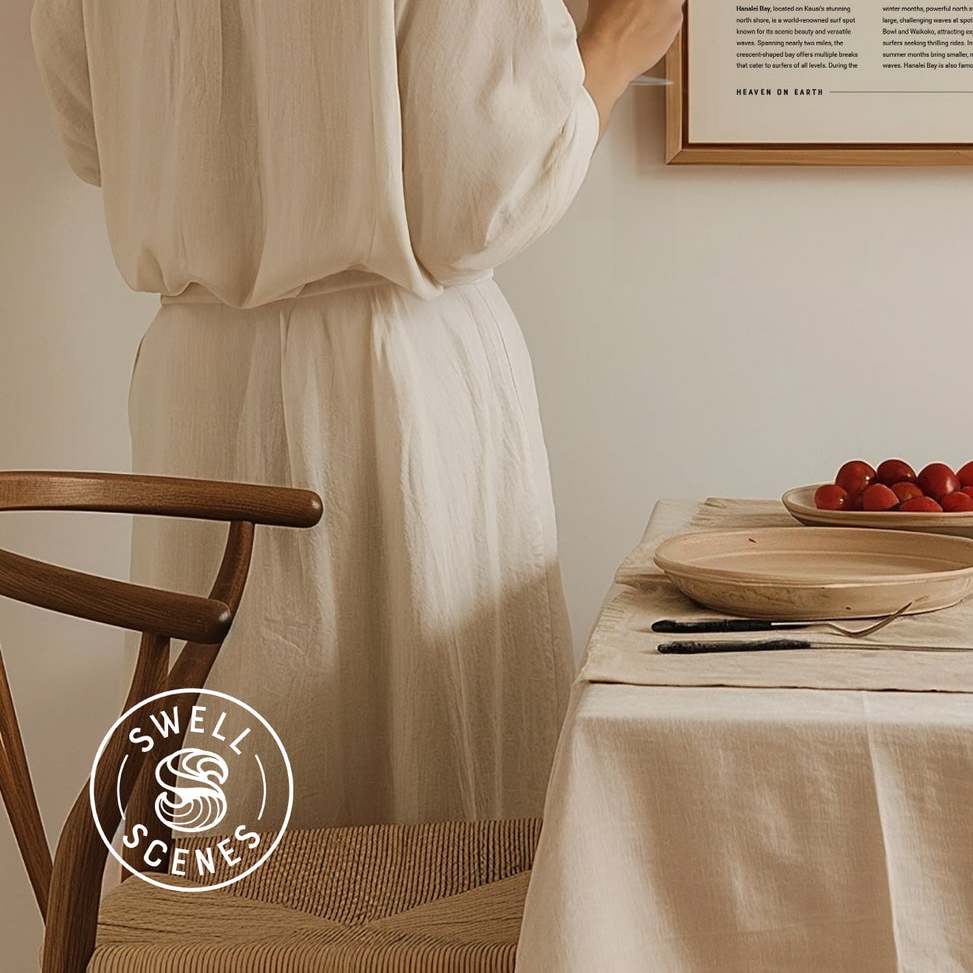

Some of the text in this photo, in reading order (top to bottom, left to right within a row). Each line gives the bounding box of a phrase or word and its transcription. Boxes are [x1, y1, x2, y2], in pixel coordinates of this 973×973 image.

[826, 5, 851, 14] stunning
[926, 5, 951, 14] powerful
[842, 17, 855, 25] spot
[899, 17, 932, 25] challenging
[794, 28, 814, 37] beauty
[937, 28, 965, 37] attracting
[757, 40, 784, 48] Spanning
[785, 40, 803, 48] nearly
[904, 40, 926, 48] seeking
[927, 40, 949, 48] thrilling
[784, 51, 795, 60] bay
[814, 51, 838, 60] multiple
[930, 51, 945, 60] bring
[828, 62, 847, 70] During
[927, 62, 937, 70] Bay
